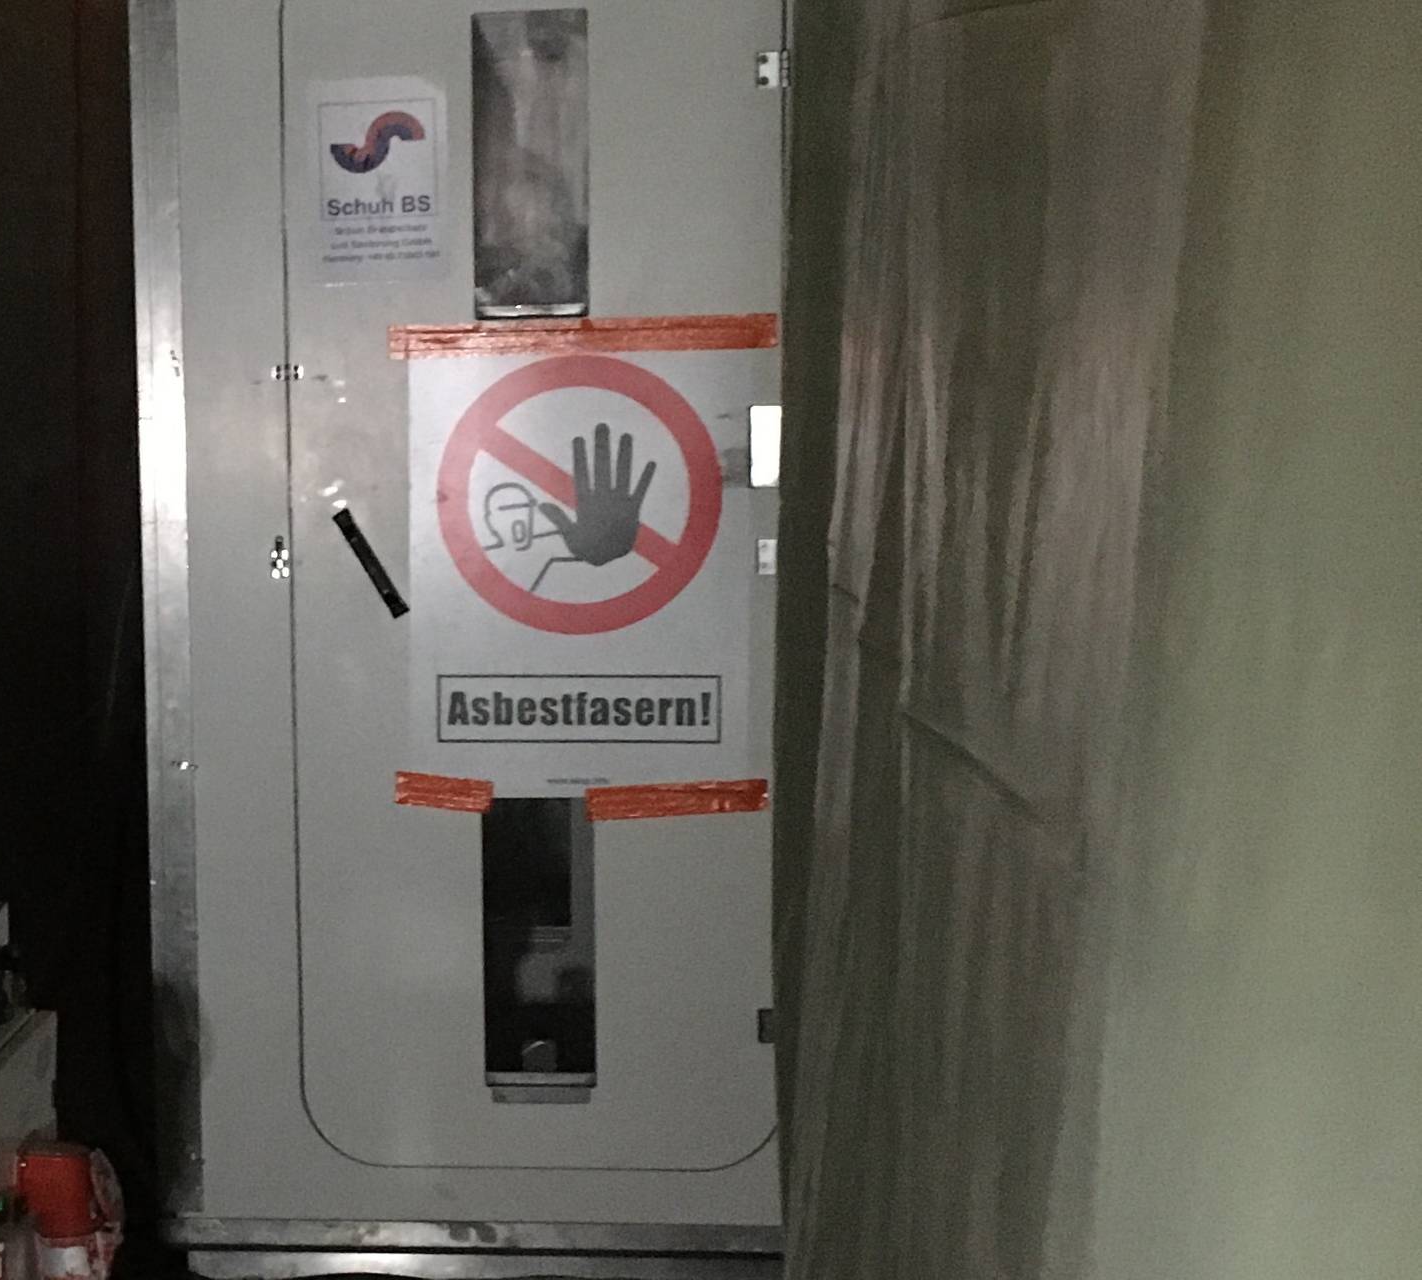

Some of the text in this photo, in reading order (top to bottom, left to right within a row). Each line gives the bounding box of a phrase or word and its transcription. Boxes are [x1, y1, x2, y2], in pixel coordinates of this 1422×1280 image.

[327, 195, 431, 216] Schuh BS
[447, 691, 712, 726] Asbestfasern!
